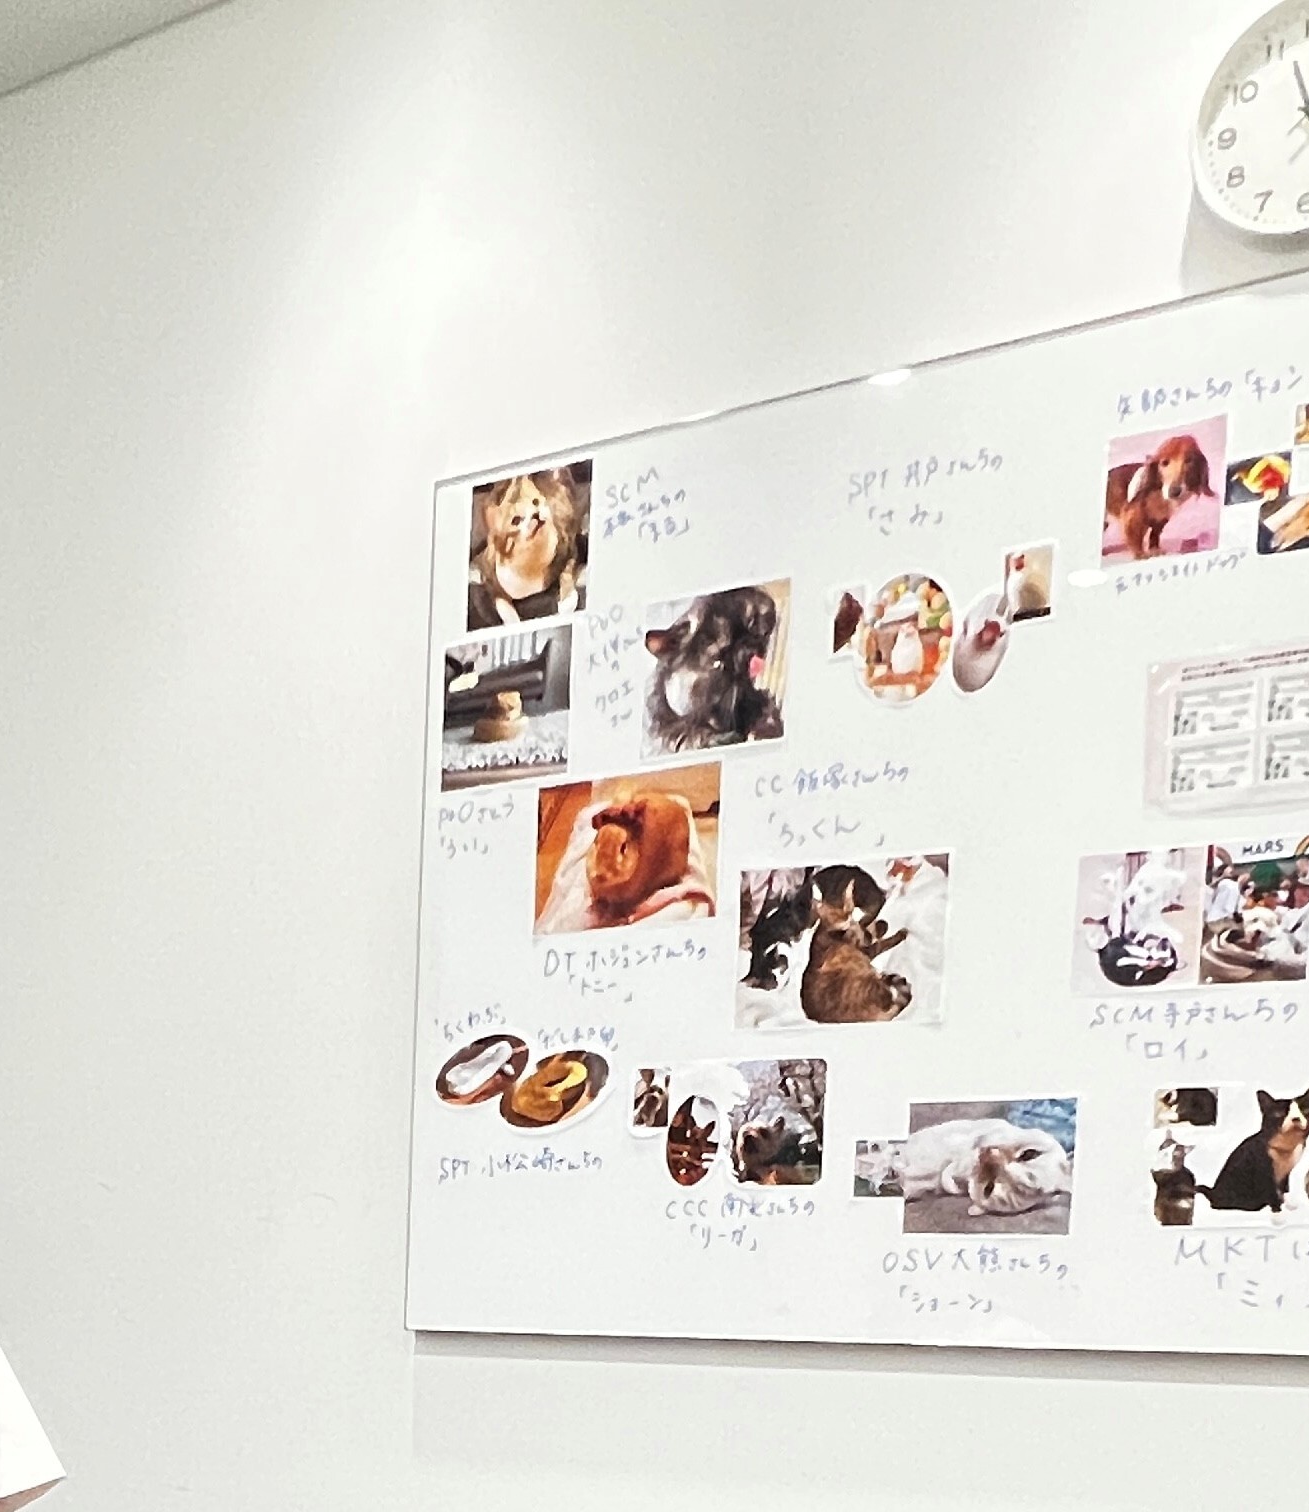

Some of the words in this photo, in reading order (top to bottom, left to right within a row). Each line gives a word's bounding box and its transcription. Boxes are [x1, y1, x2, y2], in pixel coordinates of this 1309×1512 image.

[1266, 39, 1286, 61] 11
[1233, 80, 1259, 106] 10
[1217, 127, 1237, 150] 9
[1225, 165, 1245, 188] 8
[1253, 189, 1274, 213] 7
[1241, 838, 1285, 857] MARS
[544, 949, 577, 978] DT
[1089, 1003, 1154, 1029] SCM
[437, 1155, 471, 1186] SPT
[665, 1199, 709, 1220] CCC
[882, 1248, 944, 1274] OSV
[1173, 1233, 1277, 1267] MKT
